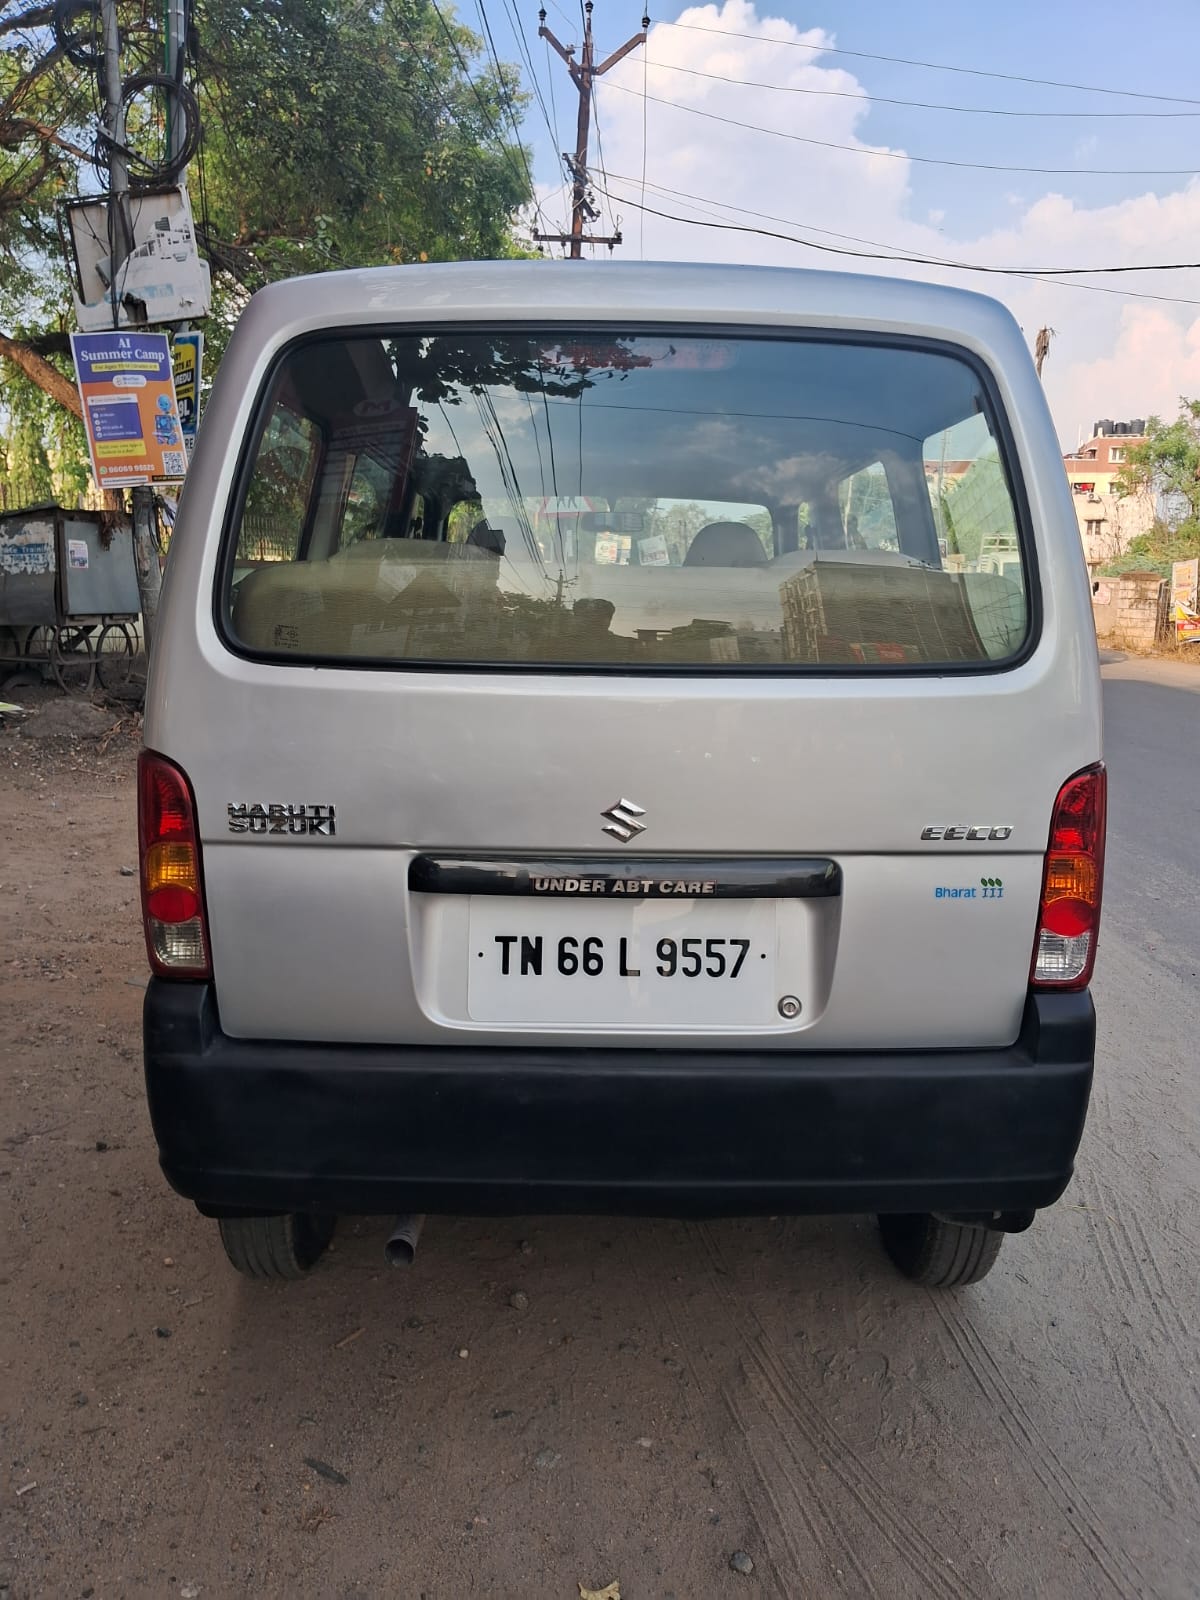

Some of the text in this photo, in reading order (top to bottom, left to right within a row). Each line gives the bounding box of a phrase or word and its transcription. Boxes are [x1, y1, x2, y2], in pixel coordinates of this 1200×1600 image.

[118, 337, 131, 348] AI
[80, 350, 132, 361] Summer
[134, 349, 165, 363] Camp
[227, 803, 336, 818] MARUTI
[228, 817, 336, 835] SUZUKI
[920, 825, 1014, 841] EECO
[534, 878, 715, 894] UNDER ABT CARE
[935, 887, 977, 898] Bharat
[494, 935, 751, 979] TN 66 L 9557
